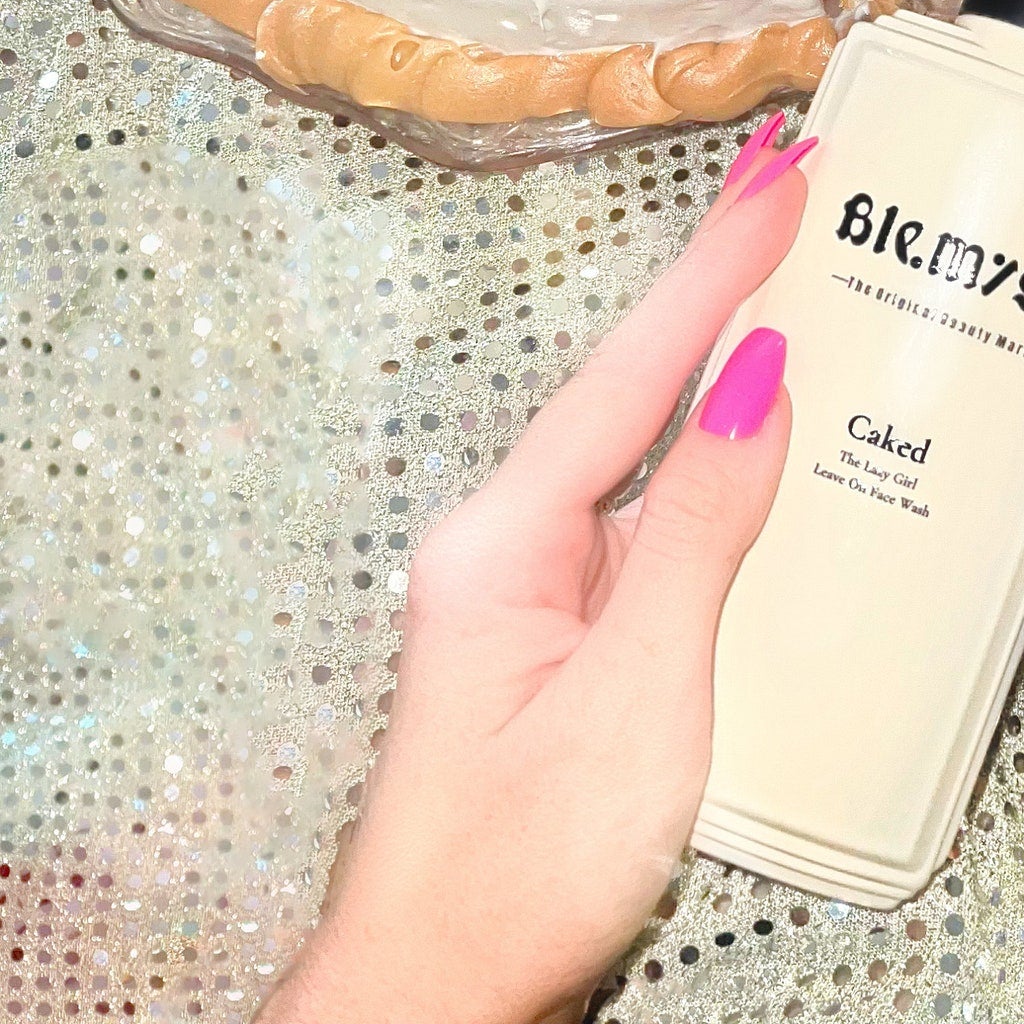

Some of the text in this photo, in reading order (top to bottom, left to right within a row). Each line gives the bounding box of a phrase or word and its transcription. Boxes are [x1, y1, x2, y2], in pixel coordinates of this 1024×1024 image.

[848, 415, 932, 464] Caked
[813, 462, 930, 517] Leave On Face Wash
[840, 450, 919, 490] The Lazy Girl
